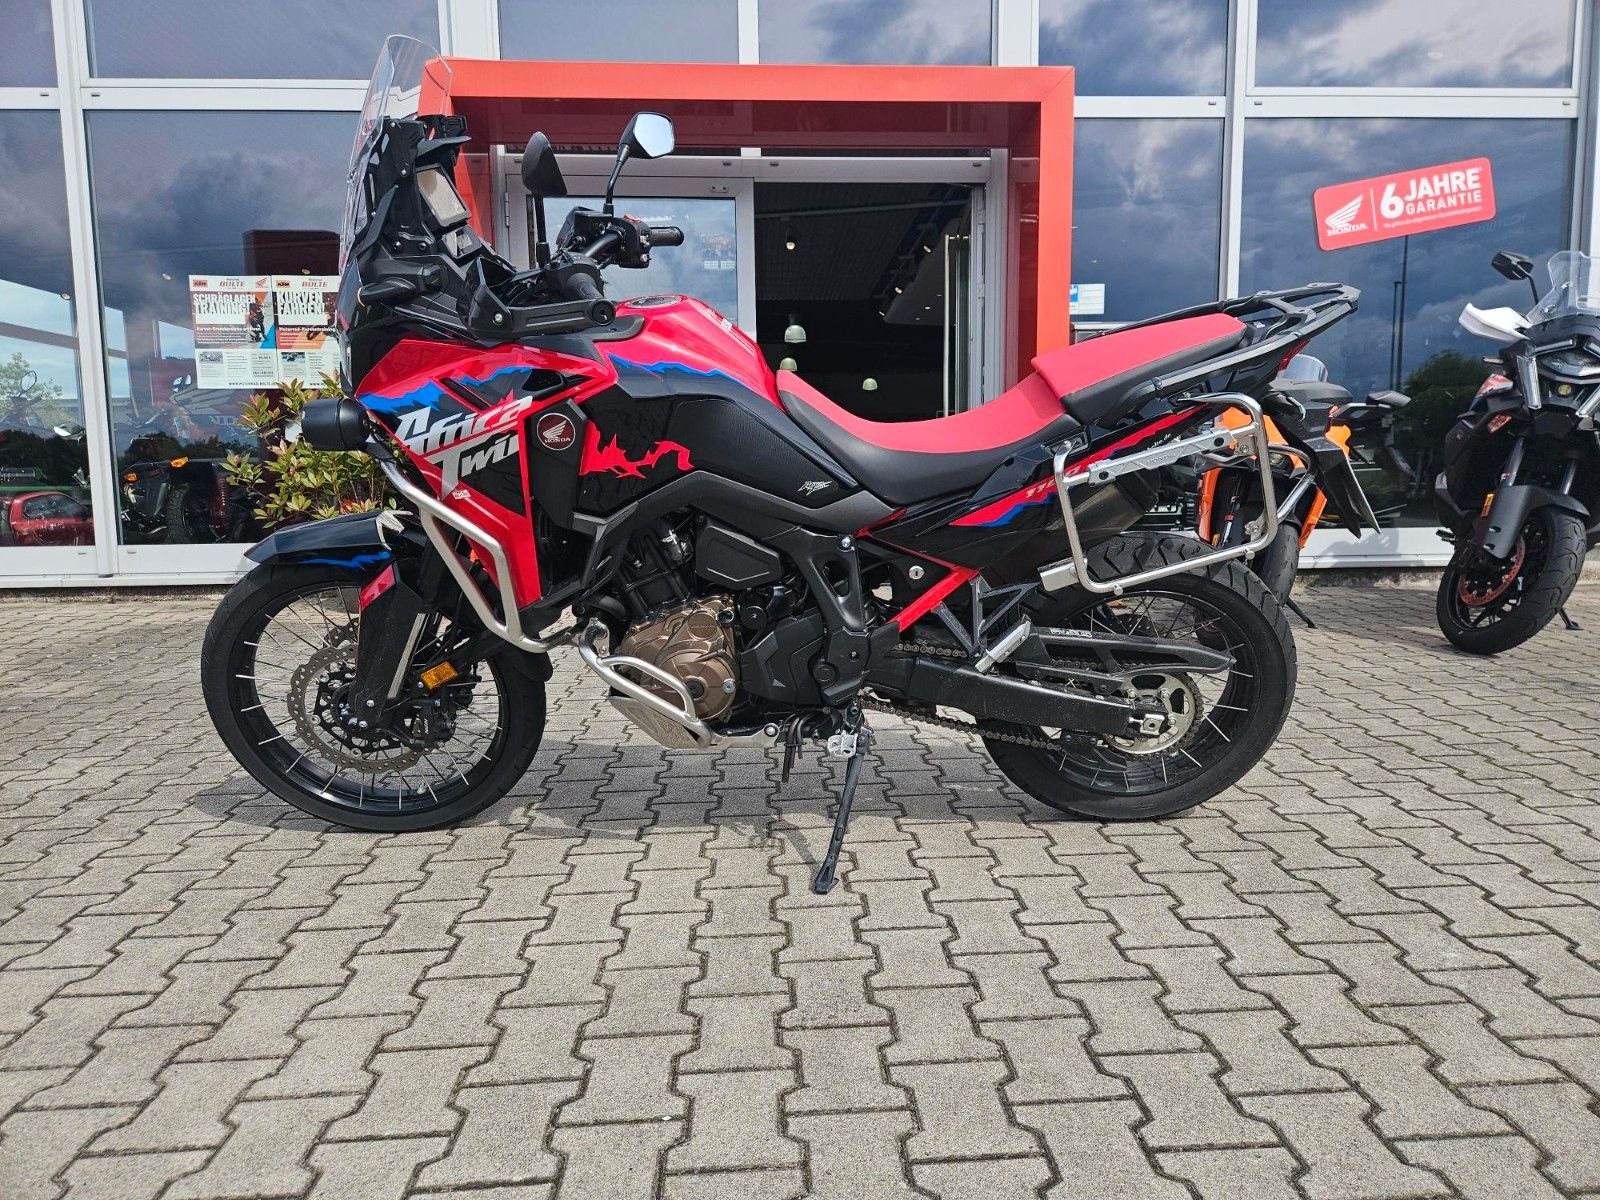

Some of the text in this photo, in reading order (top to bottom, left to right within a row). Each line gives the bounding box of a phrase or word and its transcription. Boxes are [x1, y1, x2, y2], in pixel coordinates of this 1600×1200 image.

[1380, 183, 1404, 219] 6
[1404, 168, 1482, 201] JAHRE
[1406, 190, 1482, 215] GARANTIE
[1327, 223, 1368, 237] HONDA
[193, 292, 257, 304] SCHRÄGLAGEN
[277, 291, 323, 303] KURVEN
[278, 302, 326, 315] FAHREN!
[394, 395, 533, 456] Africa
